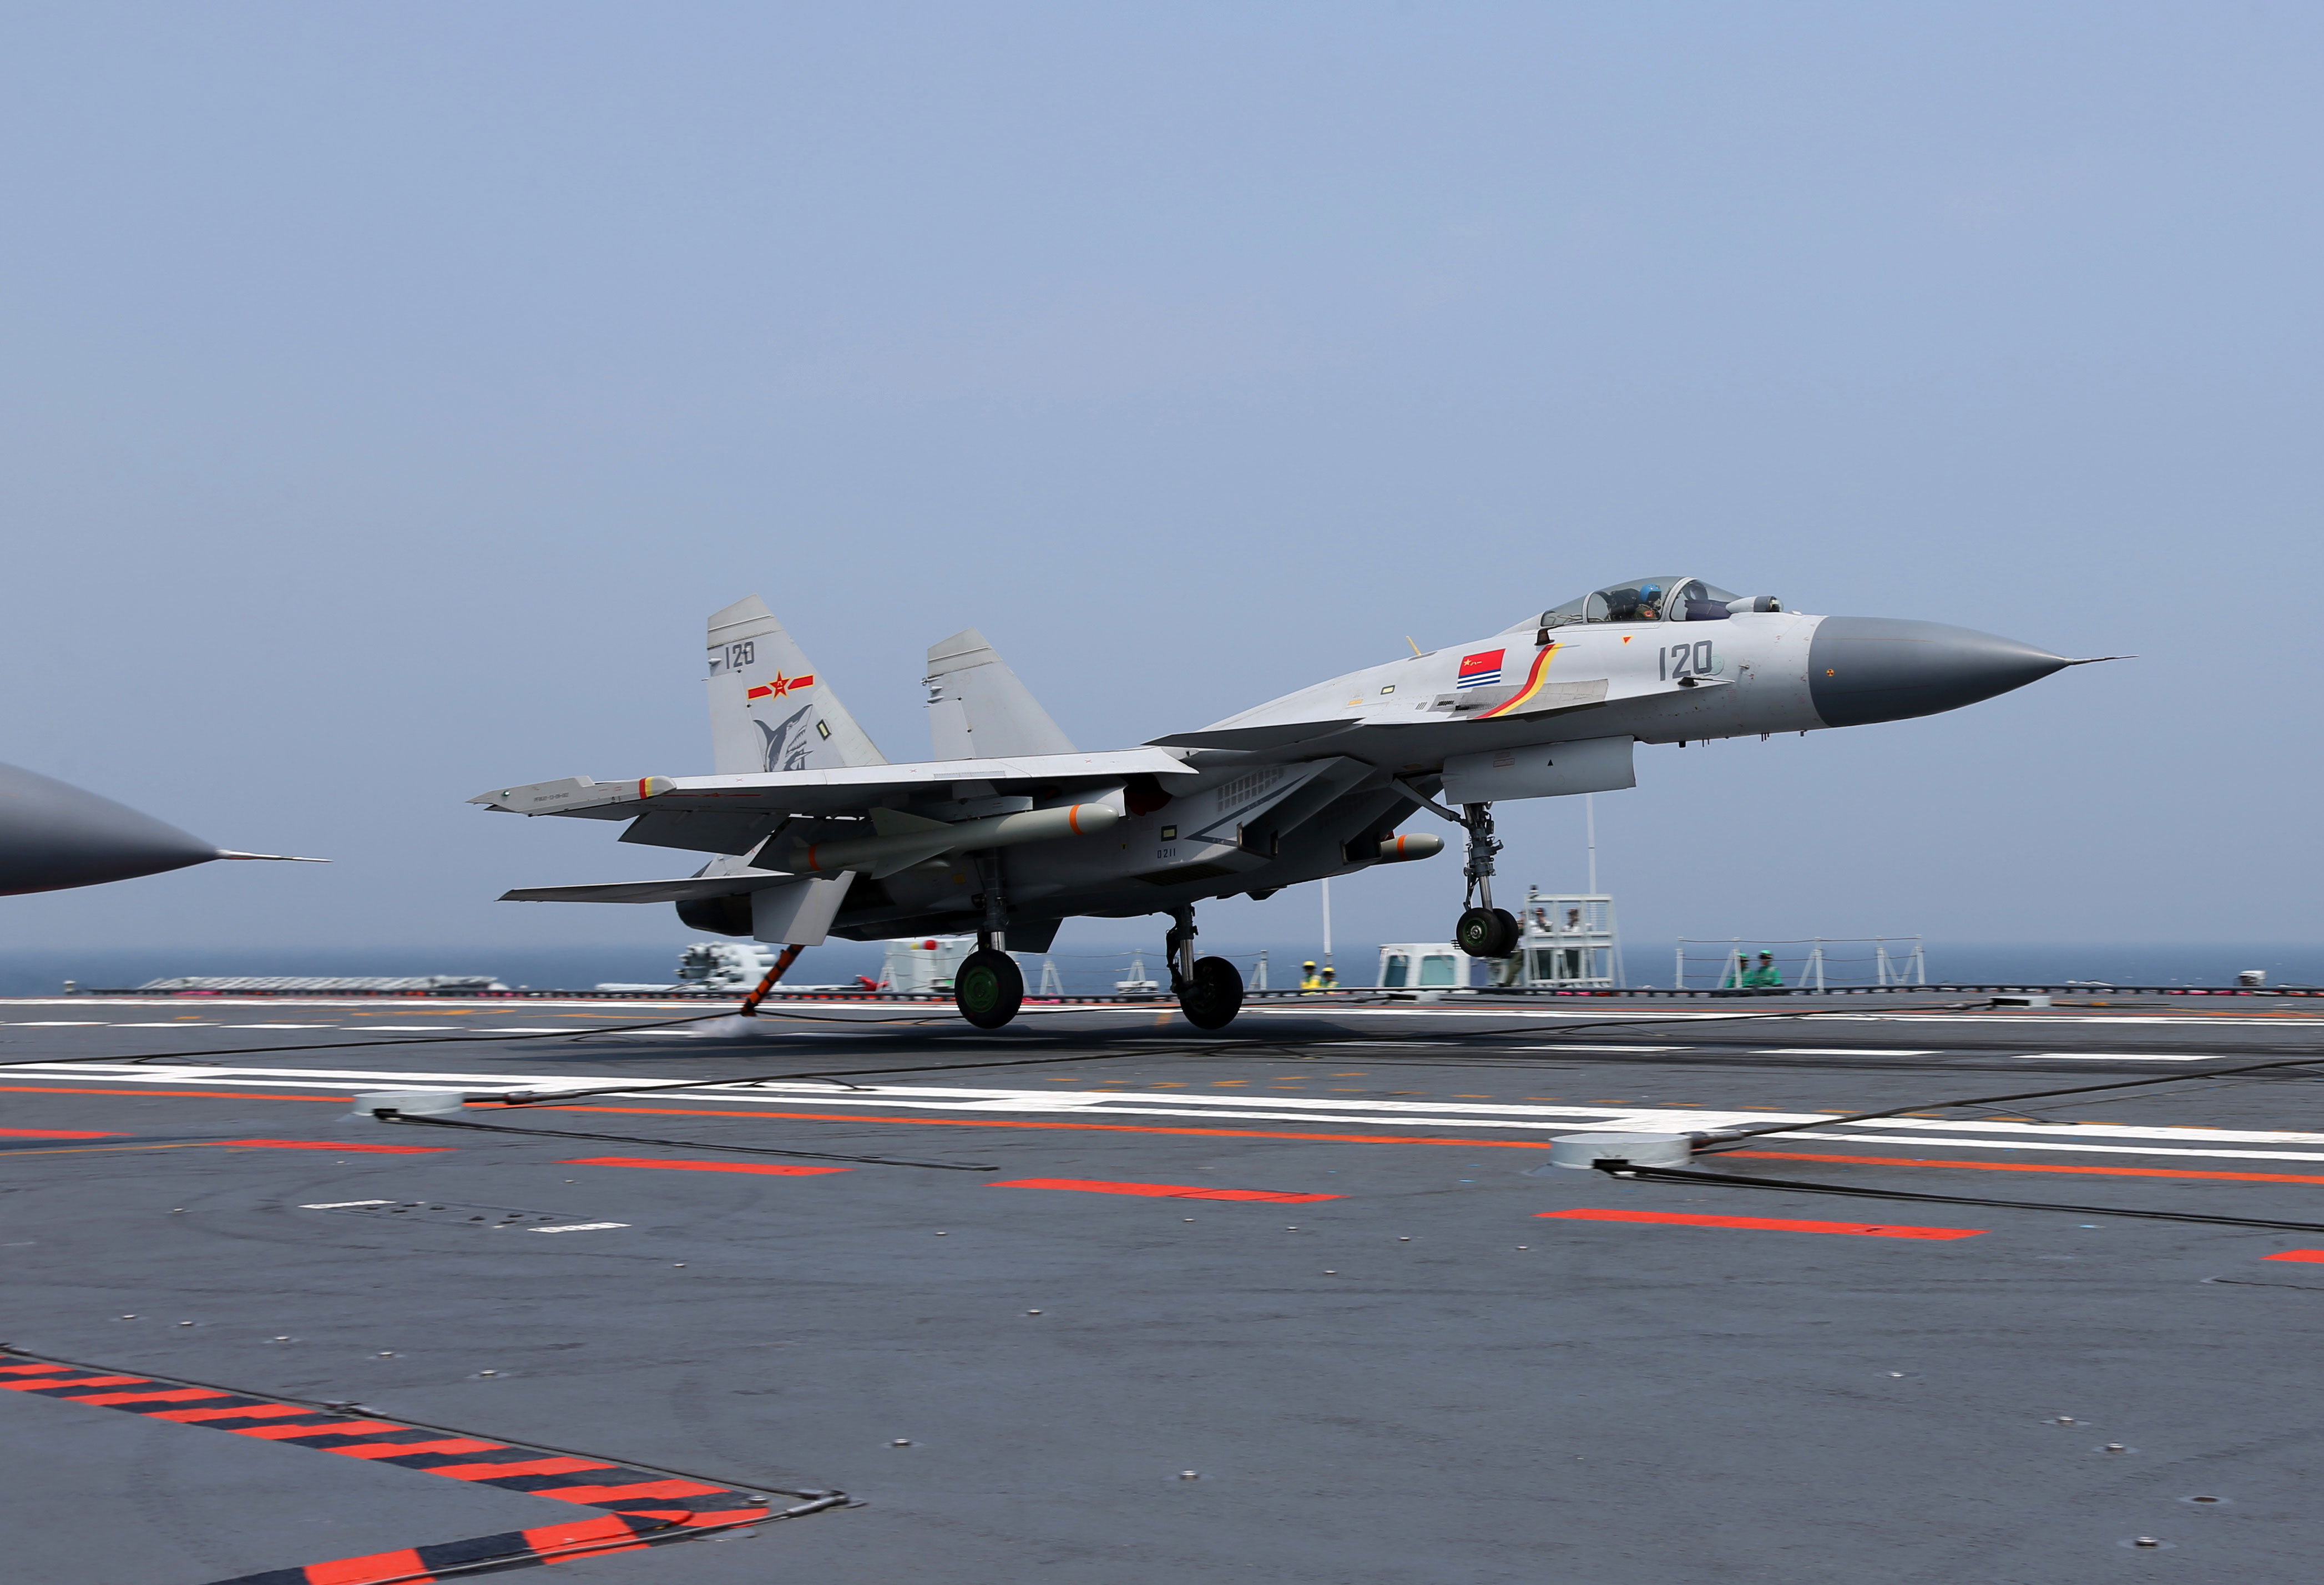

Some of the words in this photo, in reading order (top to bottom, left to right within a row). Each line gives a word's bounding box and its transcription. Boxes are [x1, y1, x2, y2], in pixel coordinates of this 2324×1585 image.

[726, 642, 755, 669] 120
[1660, 640, 1712, 682] 120
[1157, 847, 1176, 859] 0211
